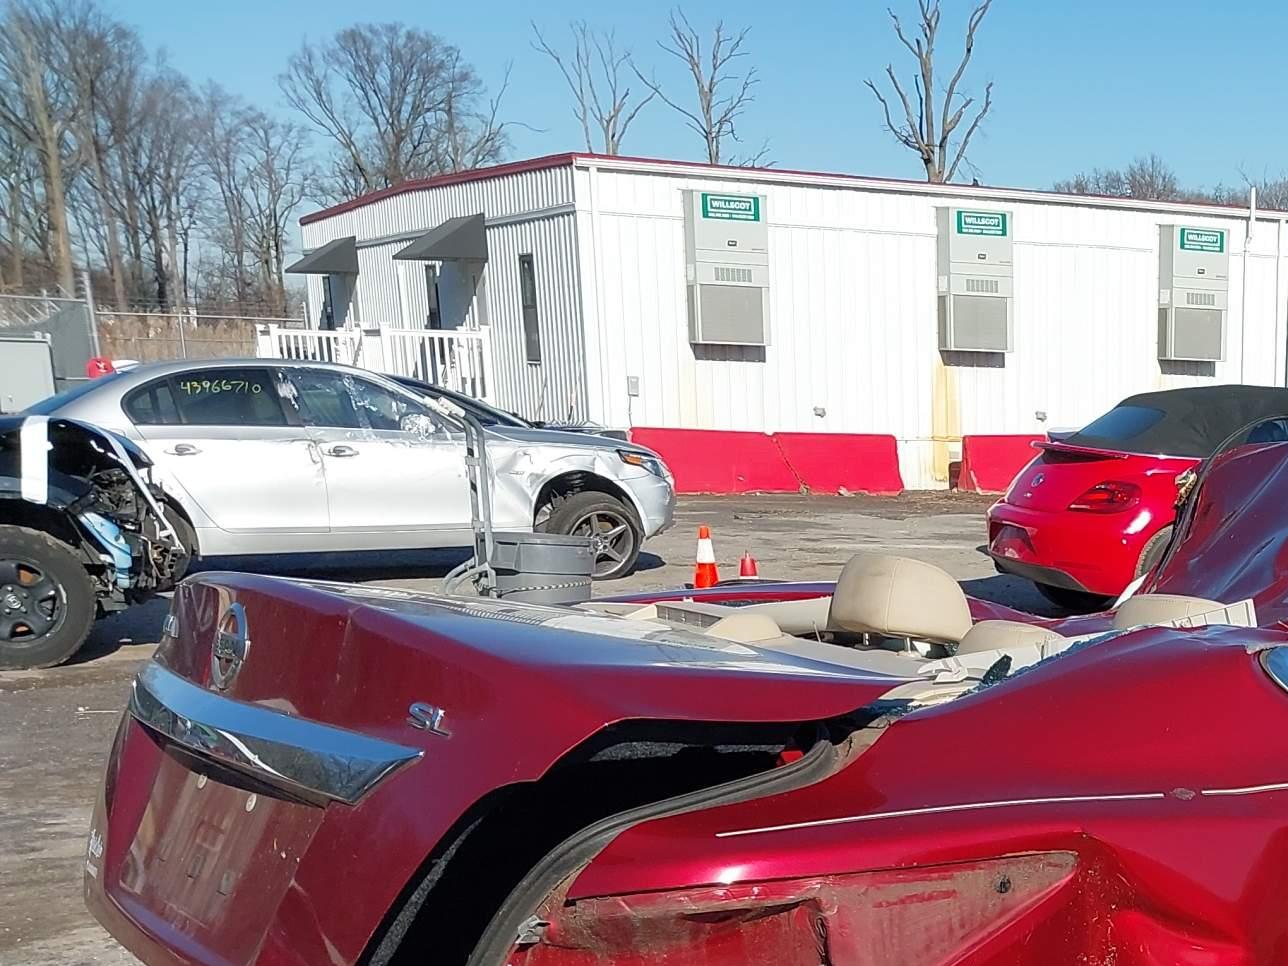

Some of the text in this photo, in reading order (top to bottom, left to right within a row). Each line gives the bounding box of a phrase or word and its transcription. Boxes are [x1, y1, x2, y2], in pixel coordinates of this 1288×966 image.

[711, 200, 751, 210] WILLSCOT
[965, 216, 999, 226] WILLSCOT
[1187, 233, 1218, 243] WILLSCOT
[180, 379, 262, 395] 43966710
[406, 702, 452, 737] SL
